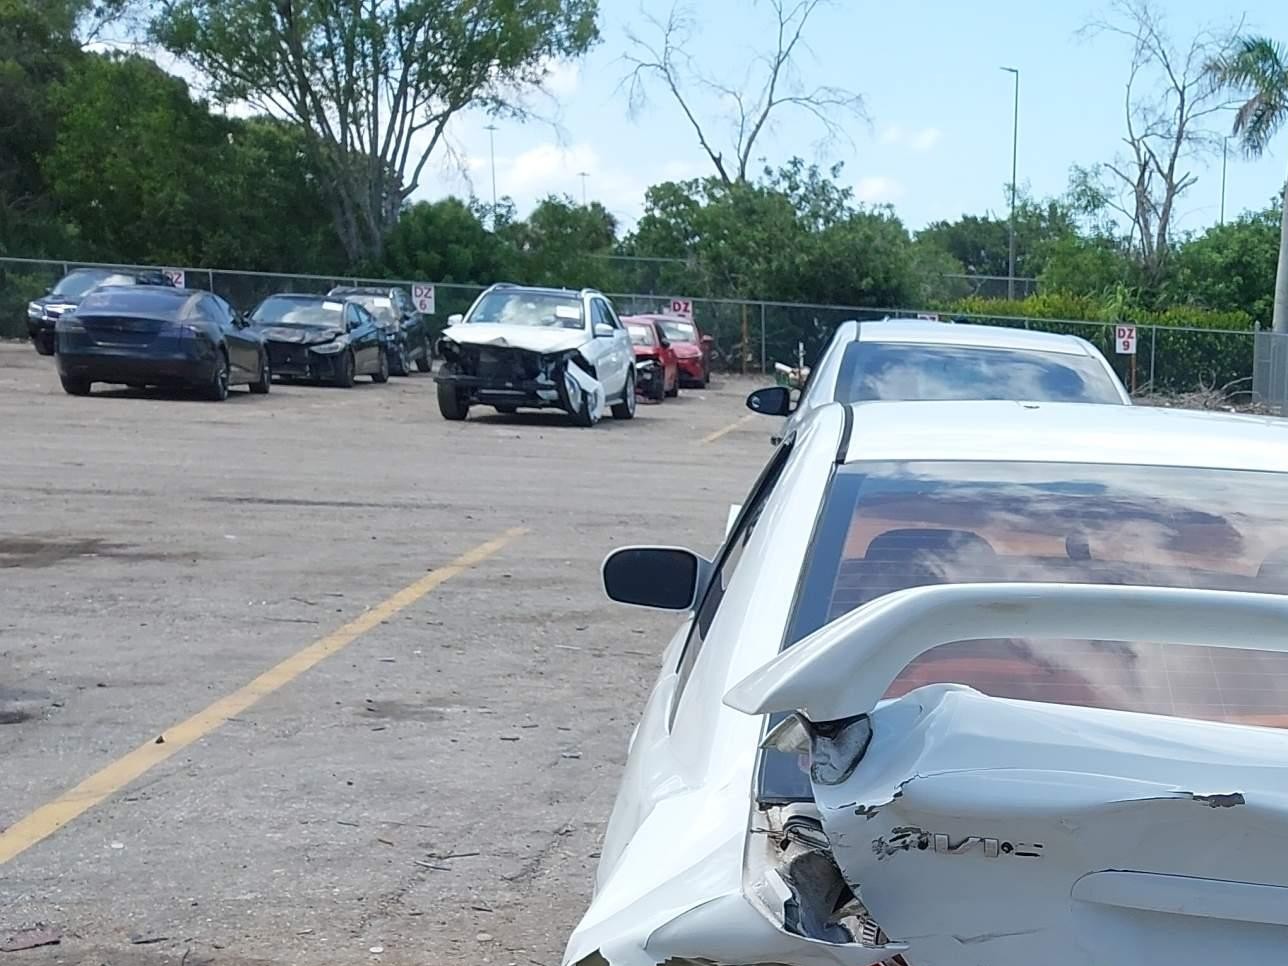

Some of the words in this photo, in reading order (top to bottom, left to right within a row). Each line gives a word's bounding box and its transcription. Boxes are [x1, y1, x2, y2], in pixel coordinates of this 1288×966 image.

[415, 286, 433, 299] DZ
[419, 299, 428, 311] 6
[672, 301, 690, 313] DZ
[1117, 327, 1135, 340] DZ
[1122, 340, 1131, 351] 9
